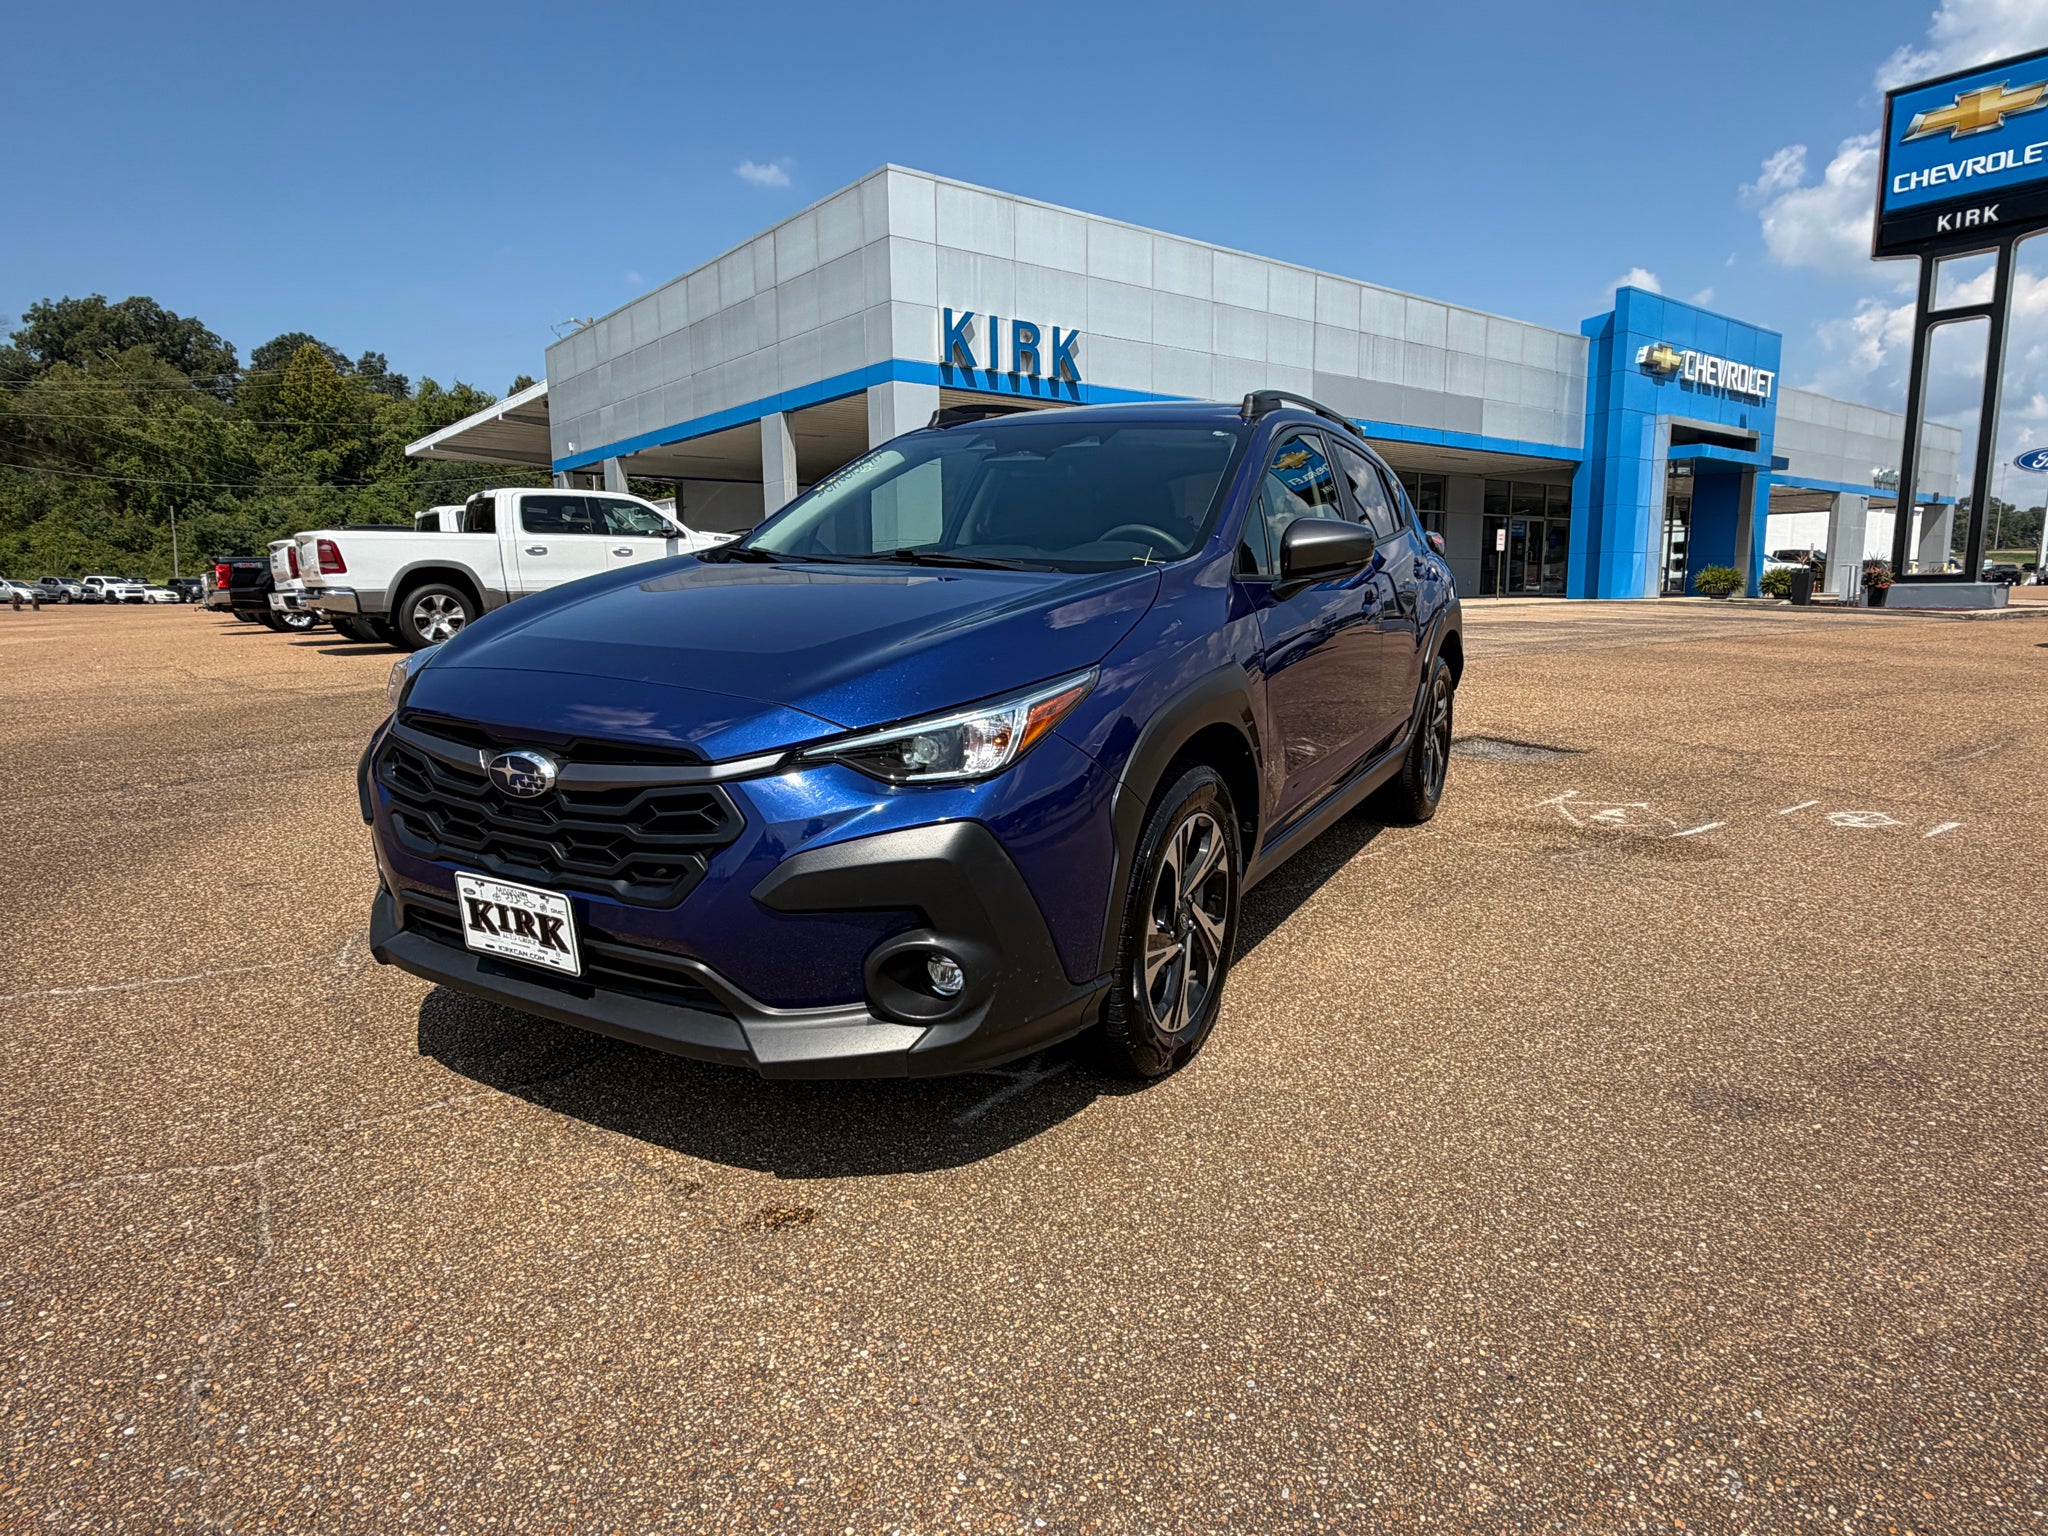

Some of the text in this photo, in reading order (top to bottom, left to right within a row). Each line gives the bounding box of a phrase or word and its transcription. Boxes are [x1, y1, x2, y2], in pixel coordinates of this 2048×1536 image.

[1936, 203, 2000, 233] KIRK
[943, 307, 1082, 383] KIRK
[1683, 349, 1776, 398] CHEVROLET
[464, 896, 571, 955] KIRK
